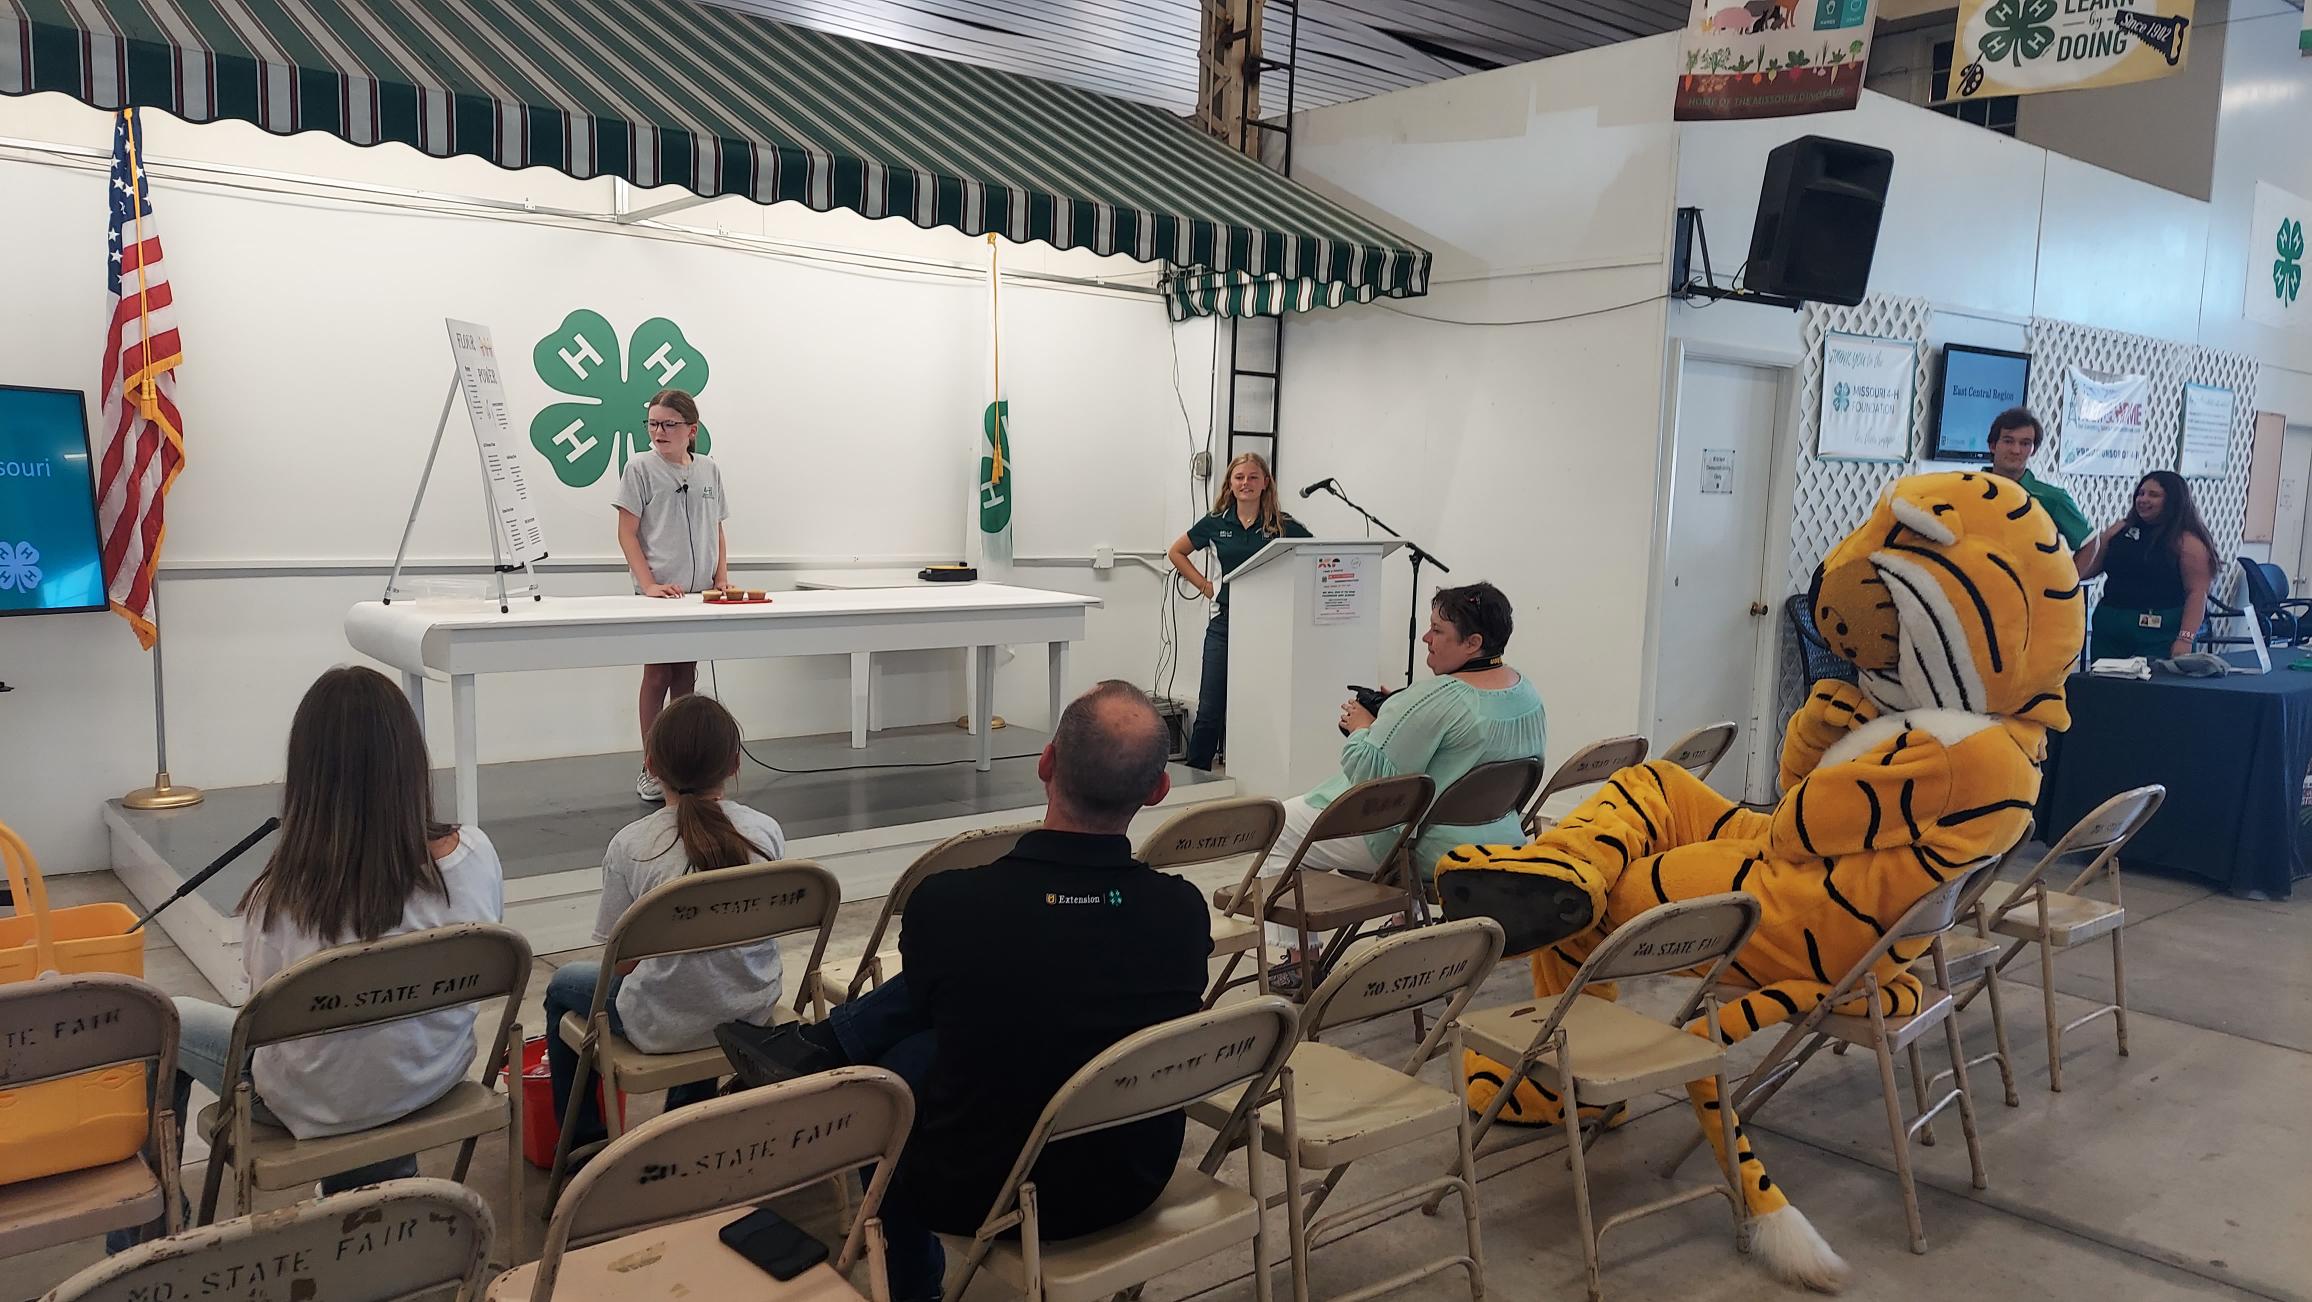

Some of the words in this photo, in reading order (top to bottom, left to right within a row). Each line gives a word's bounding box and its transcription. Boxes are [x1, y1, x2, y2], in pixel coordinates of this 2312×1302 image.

[2088, 11, 2103, 30] by
[2120, 12, 2147, 33] Since
[2147, 21, 2173, 43] 1902
[2056, 29, 2129, 62] DOING
[1851, 400, 1895, 415] FOUNDATION
[1852, 385, 1886, 399] MISSOURI
[1952, 385, 1967, 397] East
[1968, 386, 1992, 399] Central
[1992, 388, 2014, 402] Region
[1058, 895, 1101, 904] Extension
[354, 983, 420, 1009] STATE
[432, 973, 480, 997] FAIR
[1391, 969, 1437, 993] STATE
[1438, 959, 1468, 981] FAIR
[54, 1008, 121, 1039] FAIR
[696, 1137, 777, 1175] STATE
[201, 1251, 310, 1296] STATE
[335, 1218, 418, 1262] FAIR
